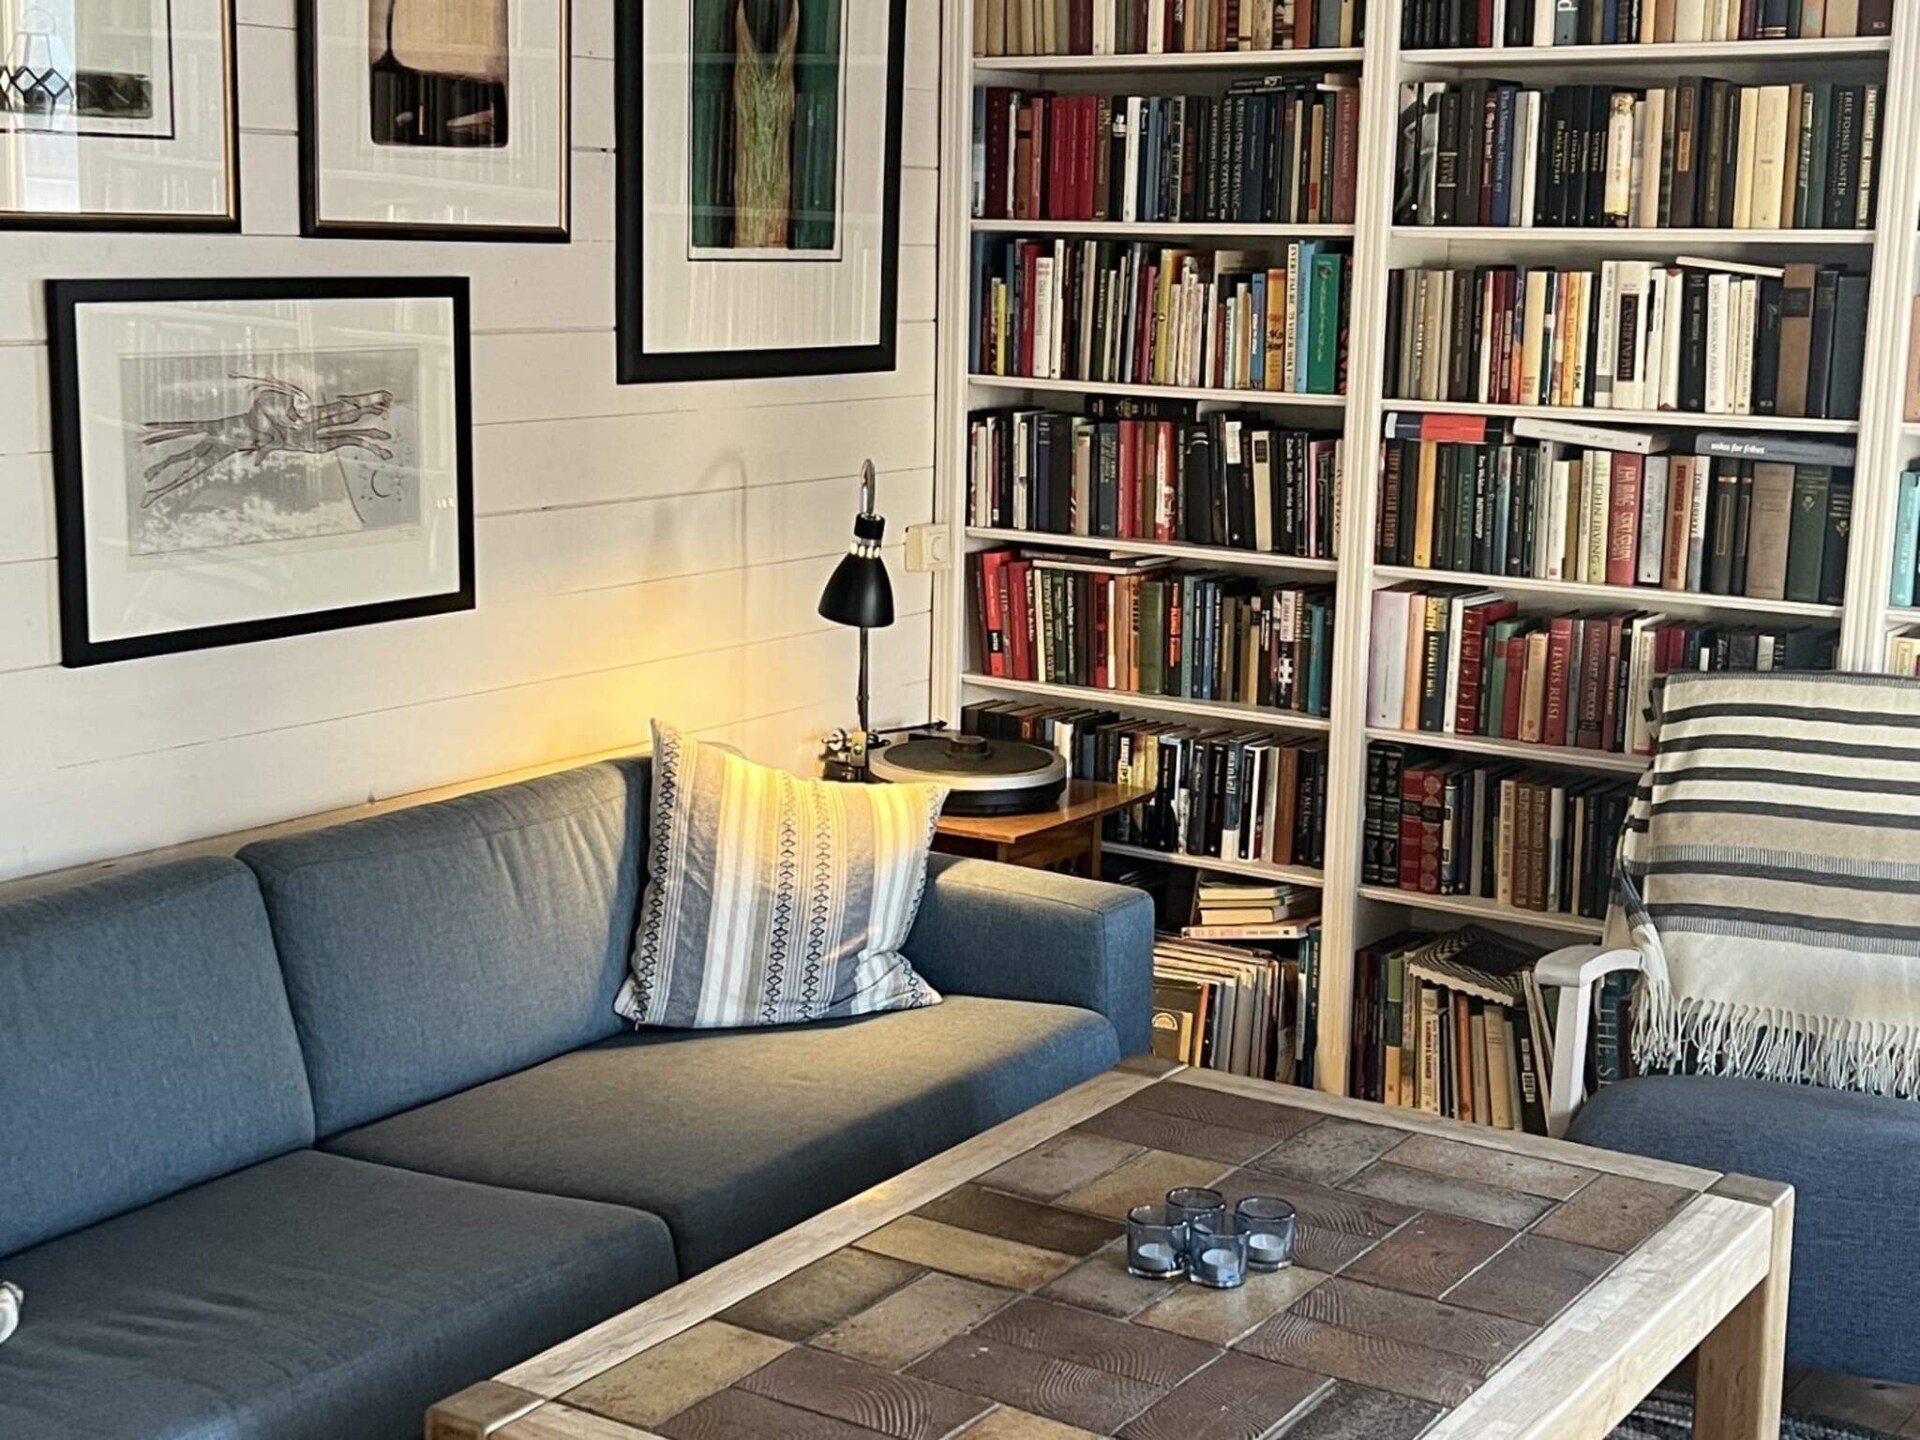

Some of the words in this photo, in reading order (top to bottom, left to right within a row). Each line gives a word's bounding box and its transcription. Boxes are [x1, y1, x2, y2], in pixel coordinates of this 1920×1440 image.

[1844, 91, 1853, 113] ERIK
[1841, 115, 1852, 151] FOSNES
[1838, 154, 1849, 195] HANSEN
[1592, 483, 1604, 513] JOHN
[1591, 520, 1601, 564] IRVING
[1551, 646, 1564, 684] LEWIS
[1590, 627, 1601, 678] MARGARET
[1586, 681, 1598, 721] ATWOOD
[1225, 751, 1236, 794] mankell
[1597, 1004, 1617, 1057] THE
